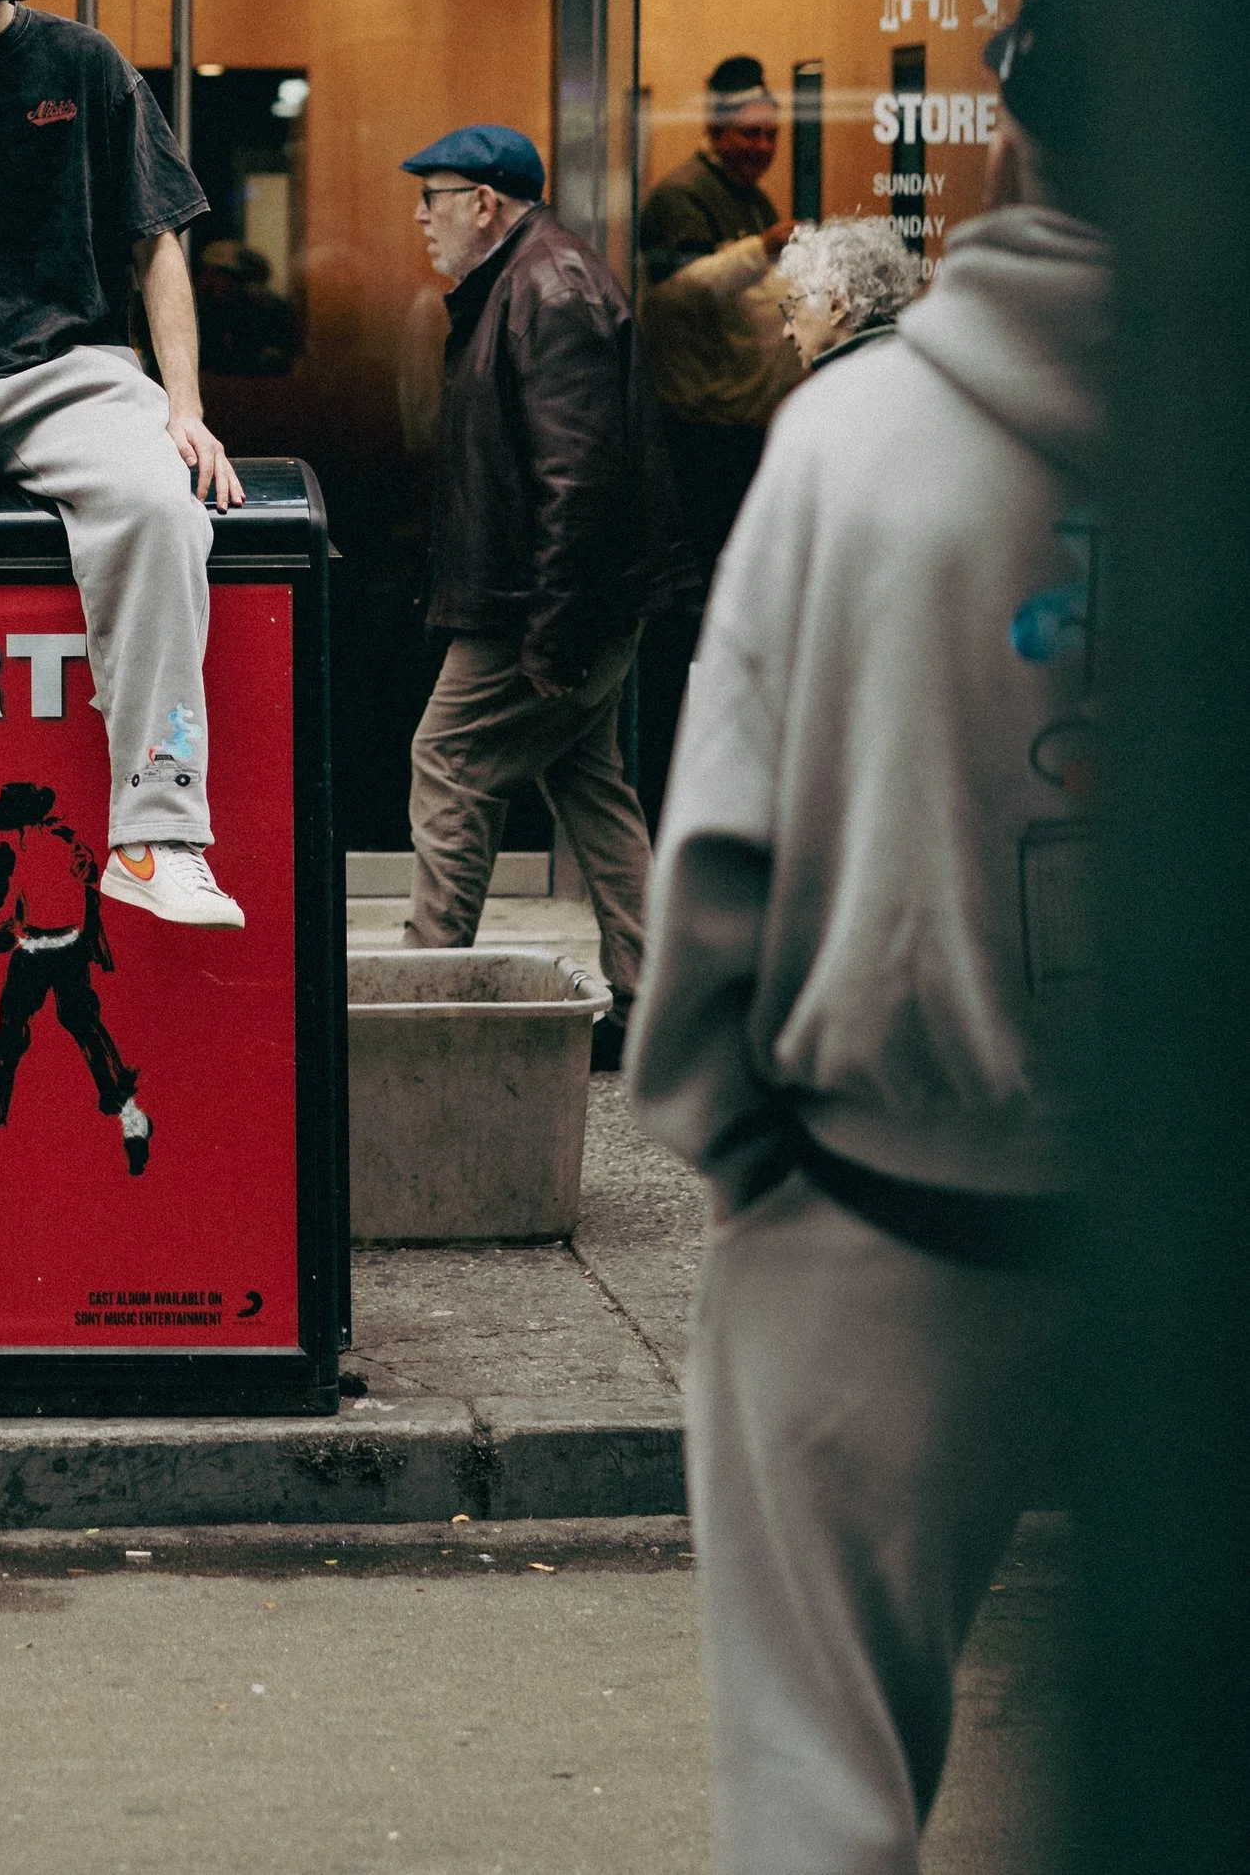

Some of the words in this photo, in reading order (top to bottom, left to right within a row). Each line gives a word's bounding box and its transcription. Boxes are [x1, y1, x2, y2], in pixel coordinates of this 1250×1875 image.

[873, 93, 999, 144] STORE
[872, 172, 946, 197] SUNDAY
[873, 214, 946, 238] ONDAY
[88, 1291, 114, 1306] CAST
[116, 1291, 152, 1306] ALBUM
[153, 1291, 206, 1306] AVAILABLE
[207, 1291, 223, 1306] ON
[74, 1311, 102, 1326] SONY
[103, 1311, 138, 1326] MUSIC
[138, 1311, 223, 1326] ENTERTAINMENT
